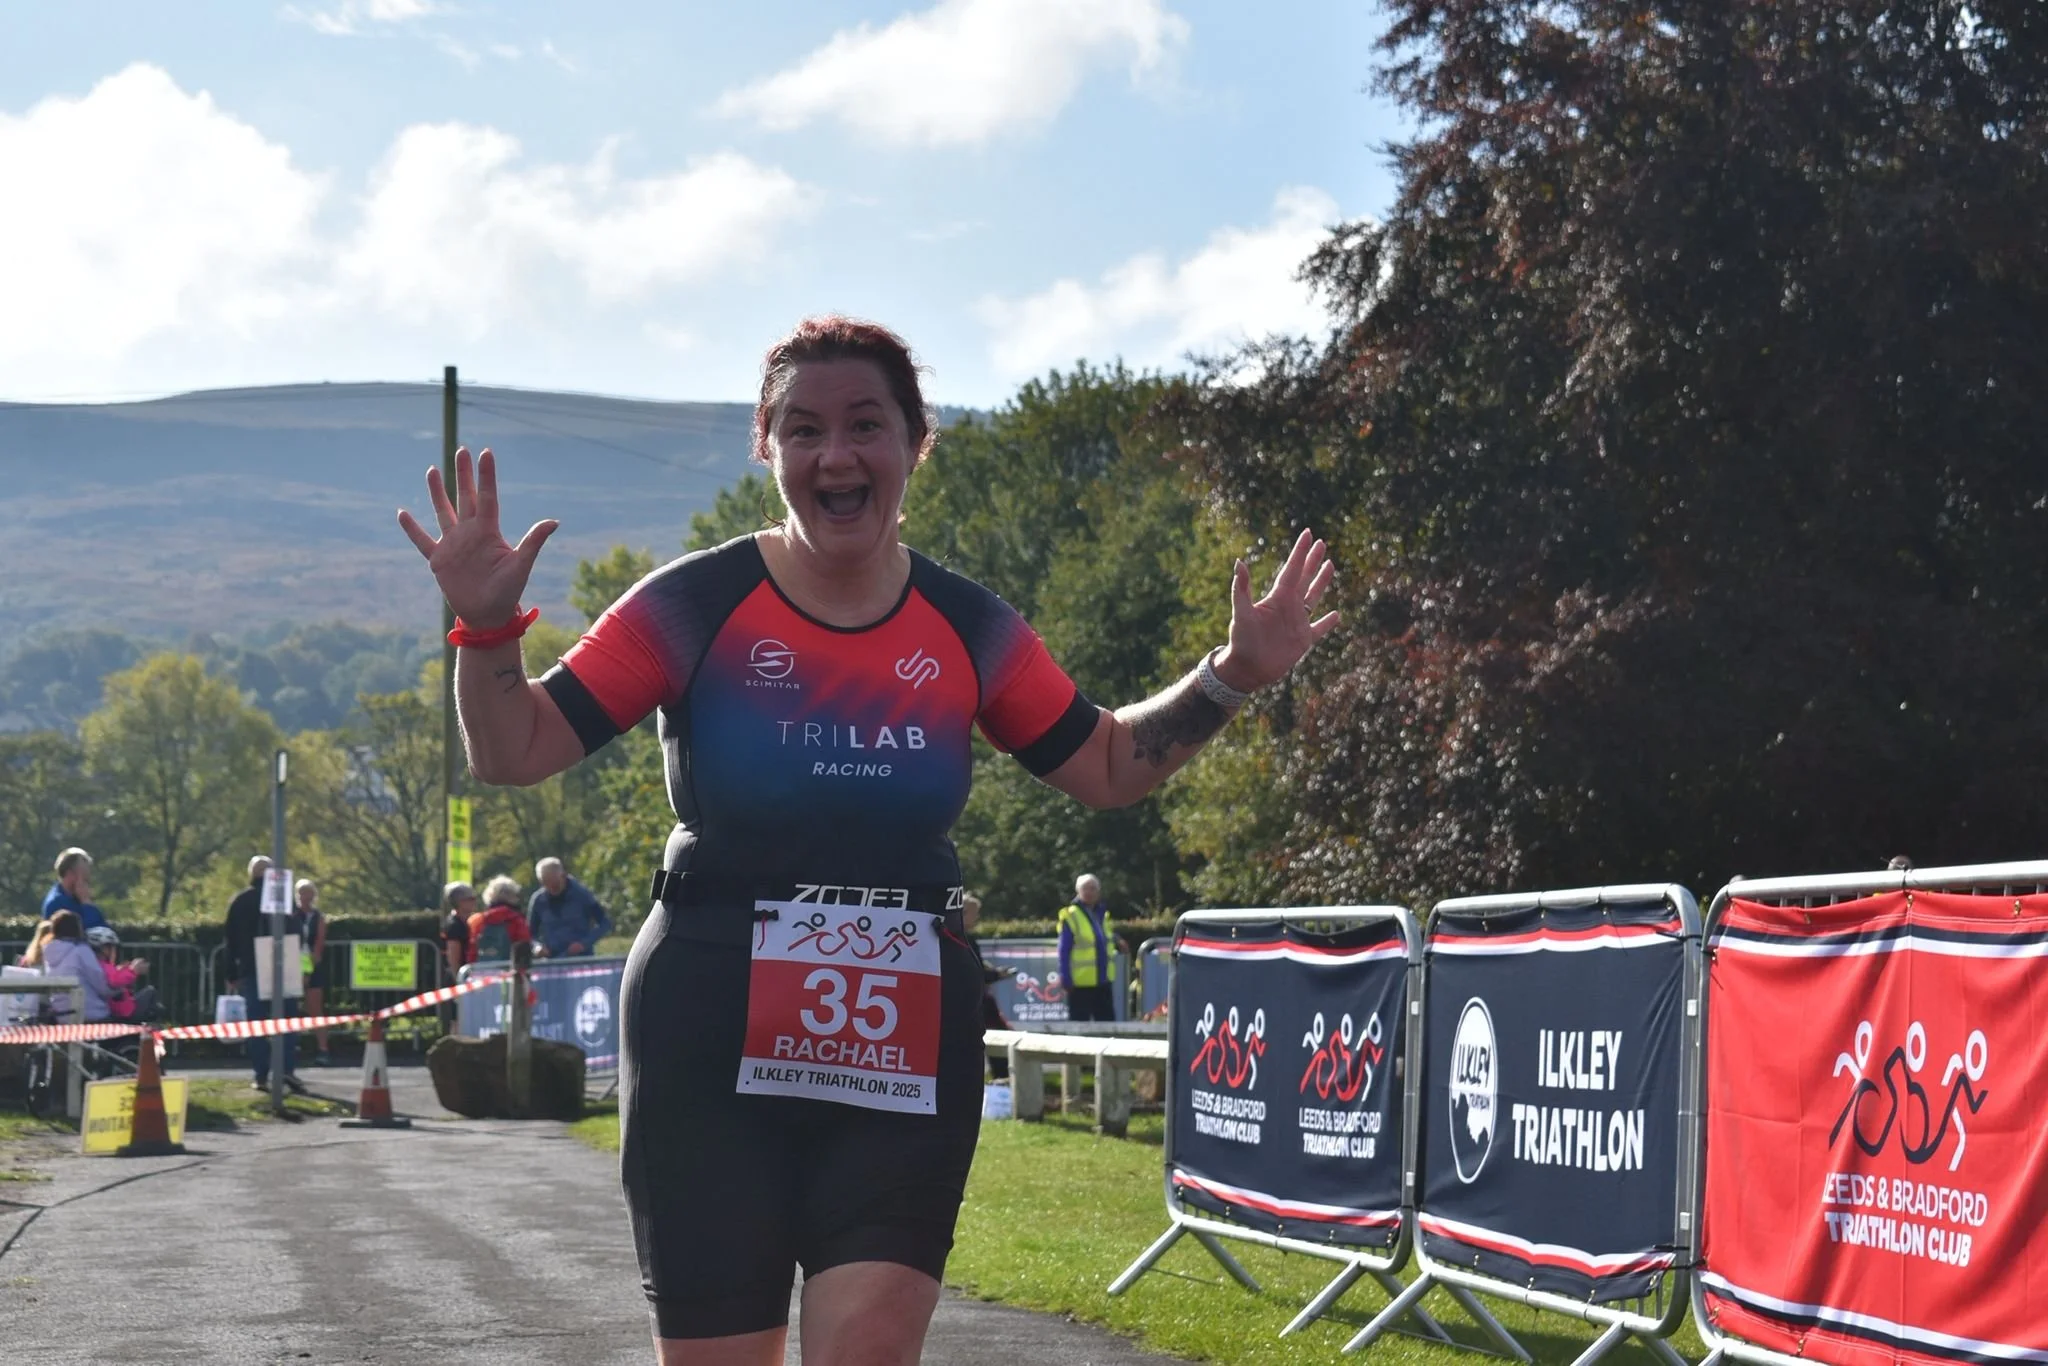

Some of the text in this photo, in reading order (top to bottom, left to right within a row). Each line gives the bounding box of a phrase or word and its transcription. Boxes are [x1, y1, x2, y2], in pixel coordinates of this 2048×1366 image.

[745, 679, 800, 690] SCIMITAR
[777, 720, 926, 750] TRILAB
[812, 761, 893, 777] RACING
[800, 968, 898, 1041] 35
[773, 1035, 911, 1072] RACHAEL
[1457, 1043, 1491, 1089] ILKLEY
[1537, 1029, 1623, 1091] ILKLEY
[752, 1066, 921, 1099] ILKLEY TRIATHLON 2025
[1192, 1088, 1266, 1121] LEEDS & BRADFORD
[1299, 1107, 1381, 1134] LEEDS & BRADFORD
[1195, 1112, 1261, 1145] TRIATHLON CLUB
[1512, 1103, 1645, 1172] TRIATHLON
[1303, 1132, 1376, 1159] TRIATHLON CLUB
[1821, 1172, 1988, 1227] LEEDS & BRADFORD
[1824, 1211, 1972, 1267] TRIATHLON CLUB
